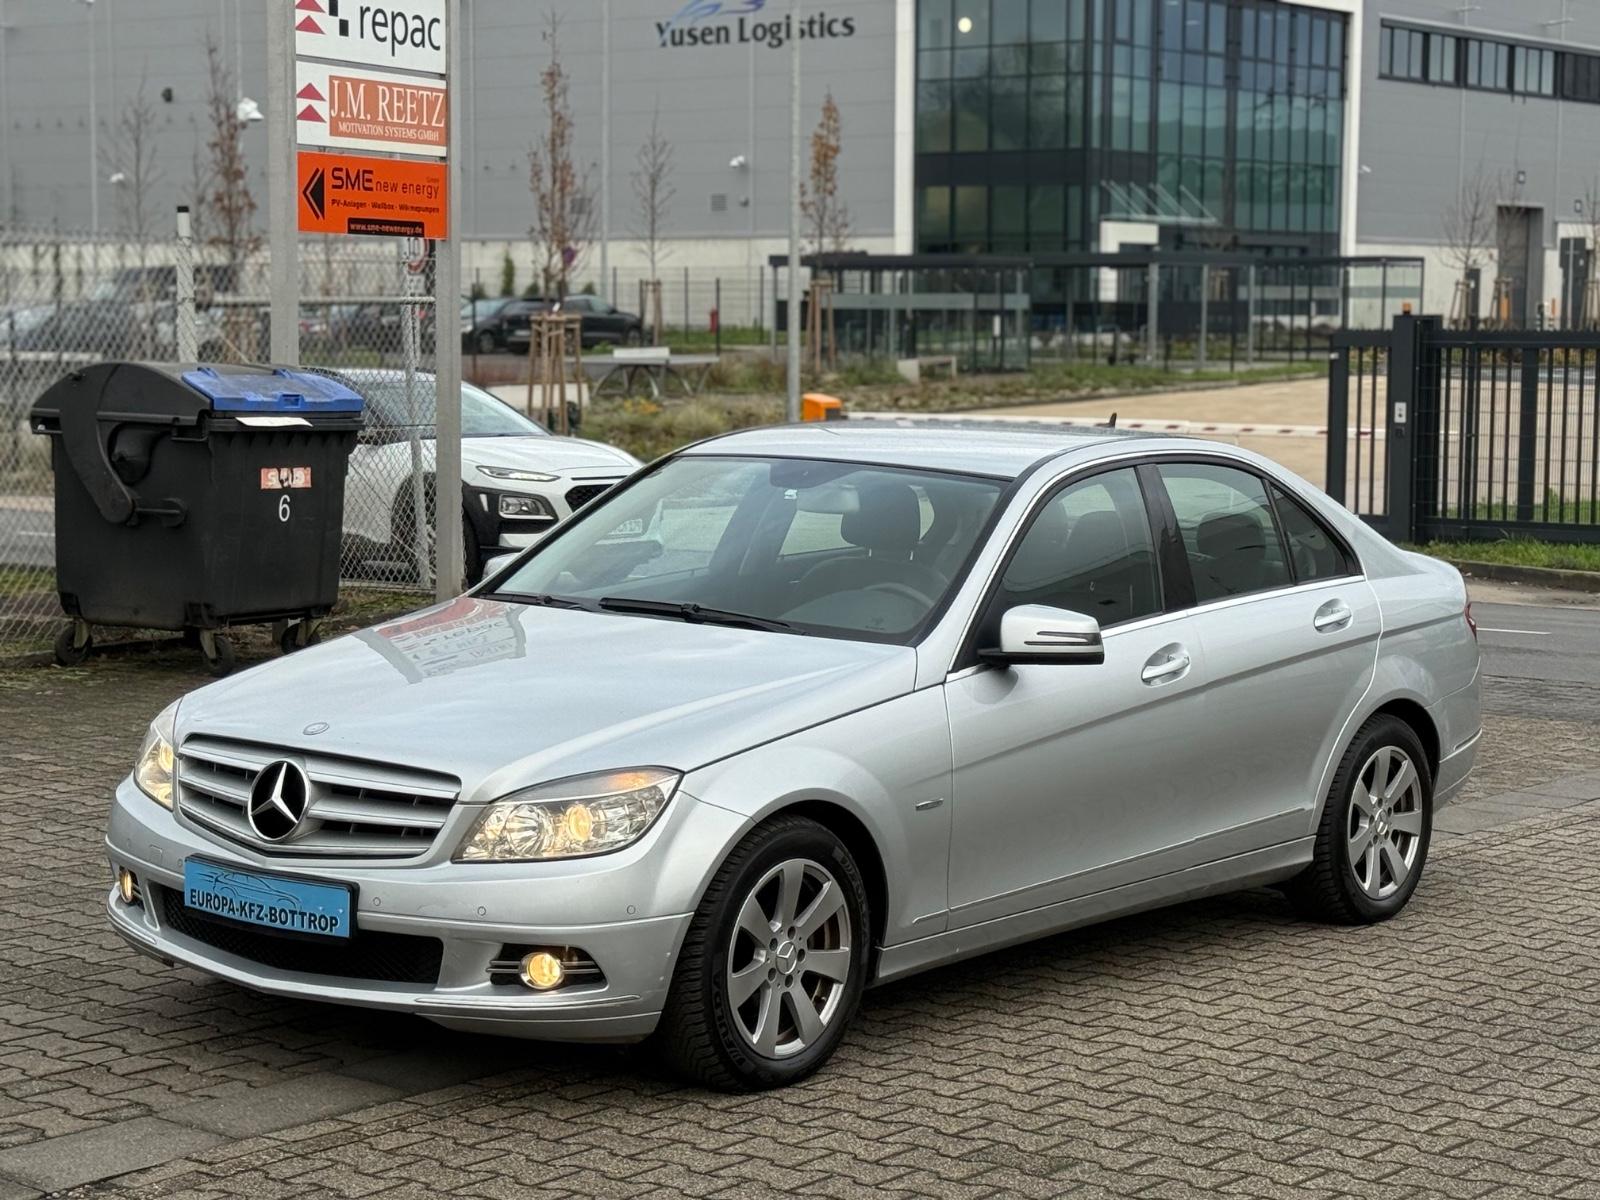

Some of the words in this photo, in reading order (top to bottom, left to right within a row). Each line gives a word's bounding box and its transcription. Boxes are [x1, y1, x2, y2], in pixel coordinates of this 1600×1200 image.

[359, 5, 441, 57] repac
[655, 21, 730, 48] Yusen
[330, 79, 371, 120] J.M.
[378, 85, 446, 128] REETZ
[338, 121, 384, 137] MOTIVATION
[385, 125, 417, 140] SYSTEMS
[418, 130, 439, 142] GMBH
[331, 167, 374, 192] SME
[375, 180, 398, 193] new
[402, 182, 439, 199] energy
[350, 223, 422, 235] www.sme-newenergy.de
[278, 494, 290, 522] 6
[190, 889, 339, 932] EUROPA-KFZ-BOTTROP
